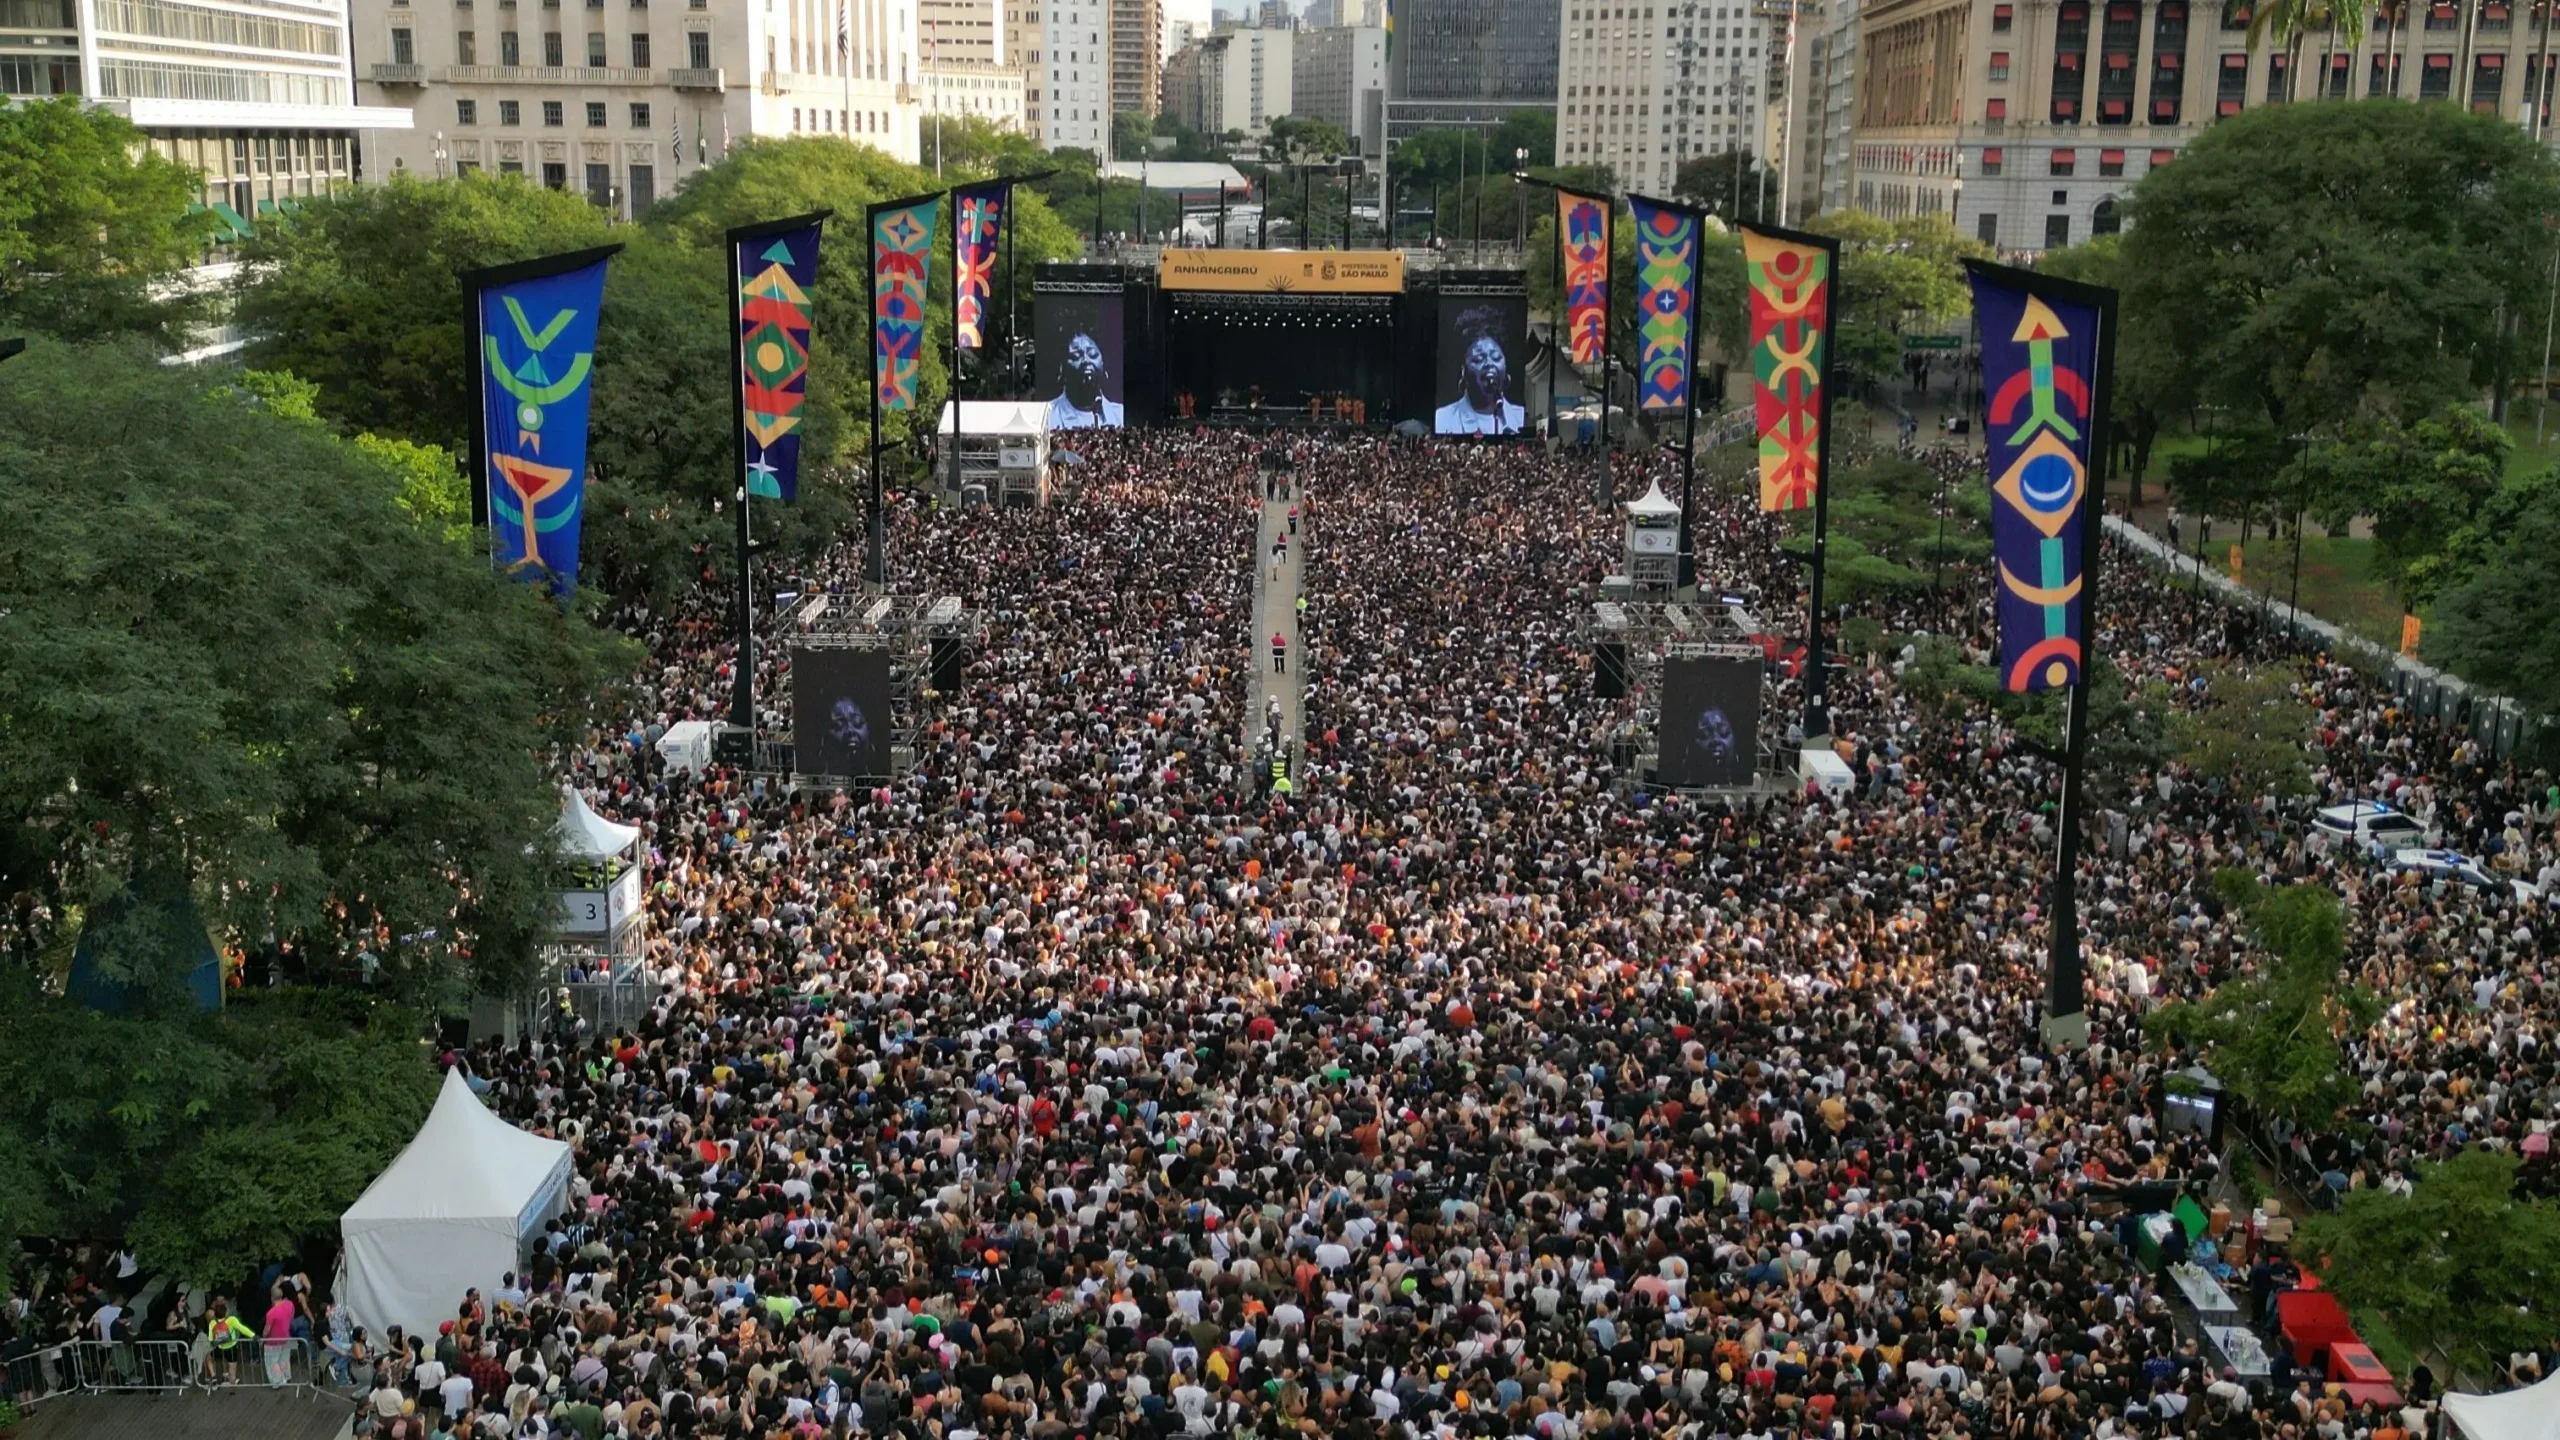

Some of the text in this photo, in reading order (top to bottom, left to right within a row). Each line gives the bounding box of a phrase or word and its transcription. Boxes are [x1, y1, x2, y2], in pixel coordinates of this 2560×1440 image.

[1341, 269, 1389, 278] SÃO PAULO
[1666, 536, 1672, 547] 2
[585, 903, 597, 920] 3
